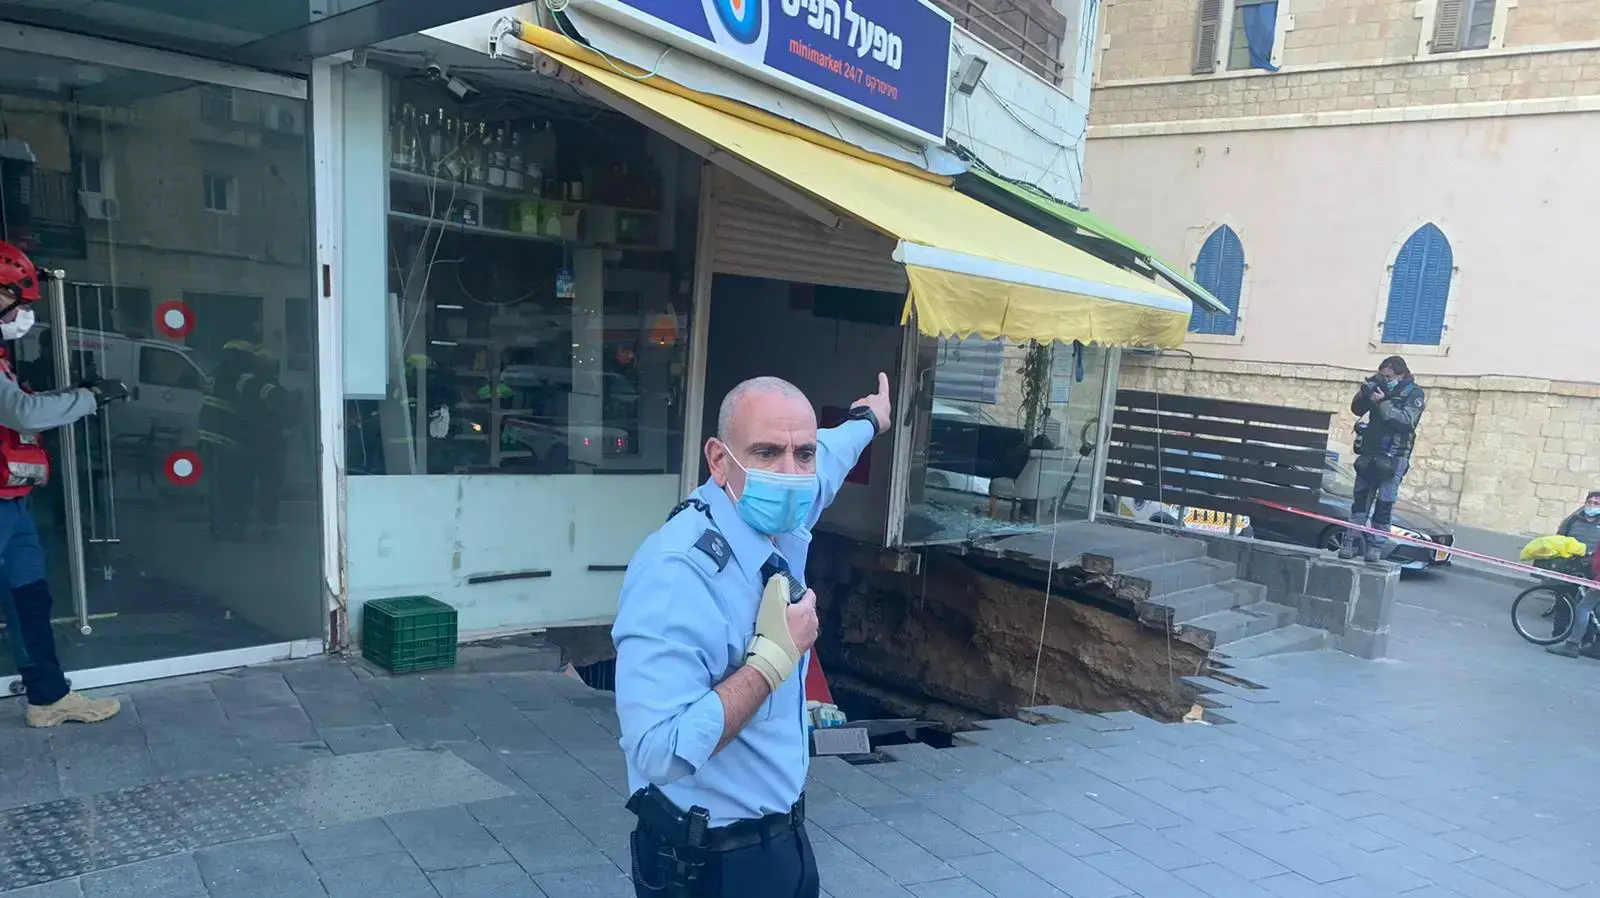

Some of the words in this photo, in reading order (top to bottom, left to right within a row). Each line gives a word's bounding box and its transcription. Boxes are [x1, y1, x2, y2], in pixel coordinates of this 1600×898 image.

[789, 40, 842, 75] minimarket
[844, 63, 864, 83] 24/7
[844, 0, 902, 70] מפעל
